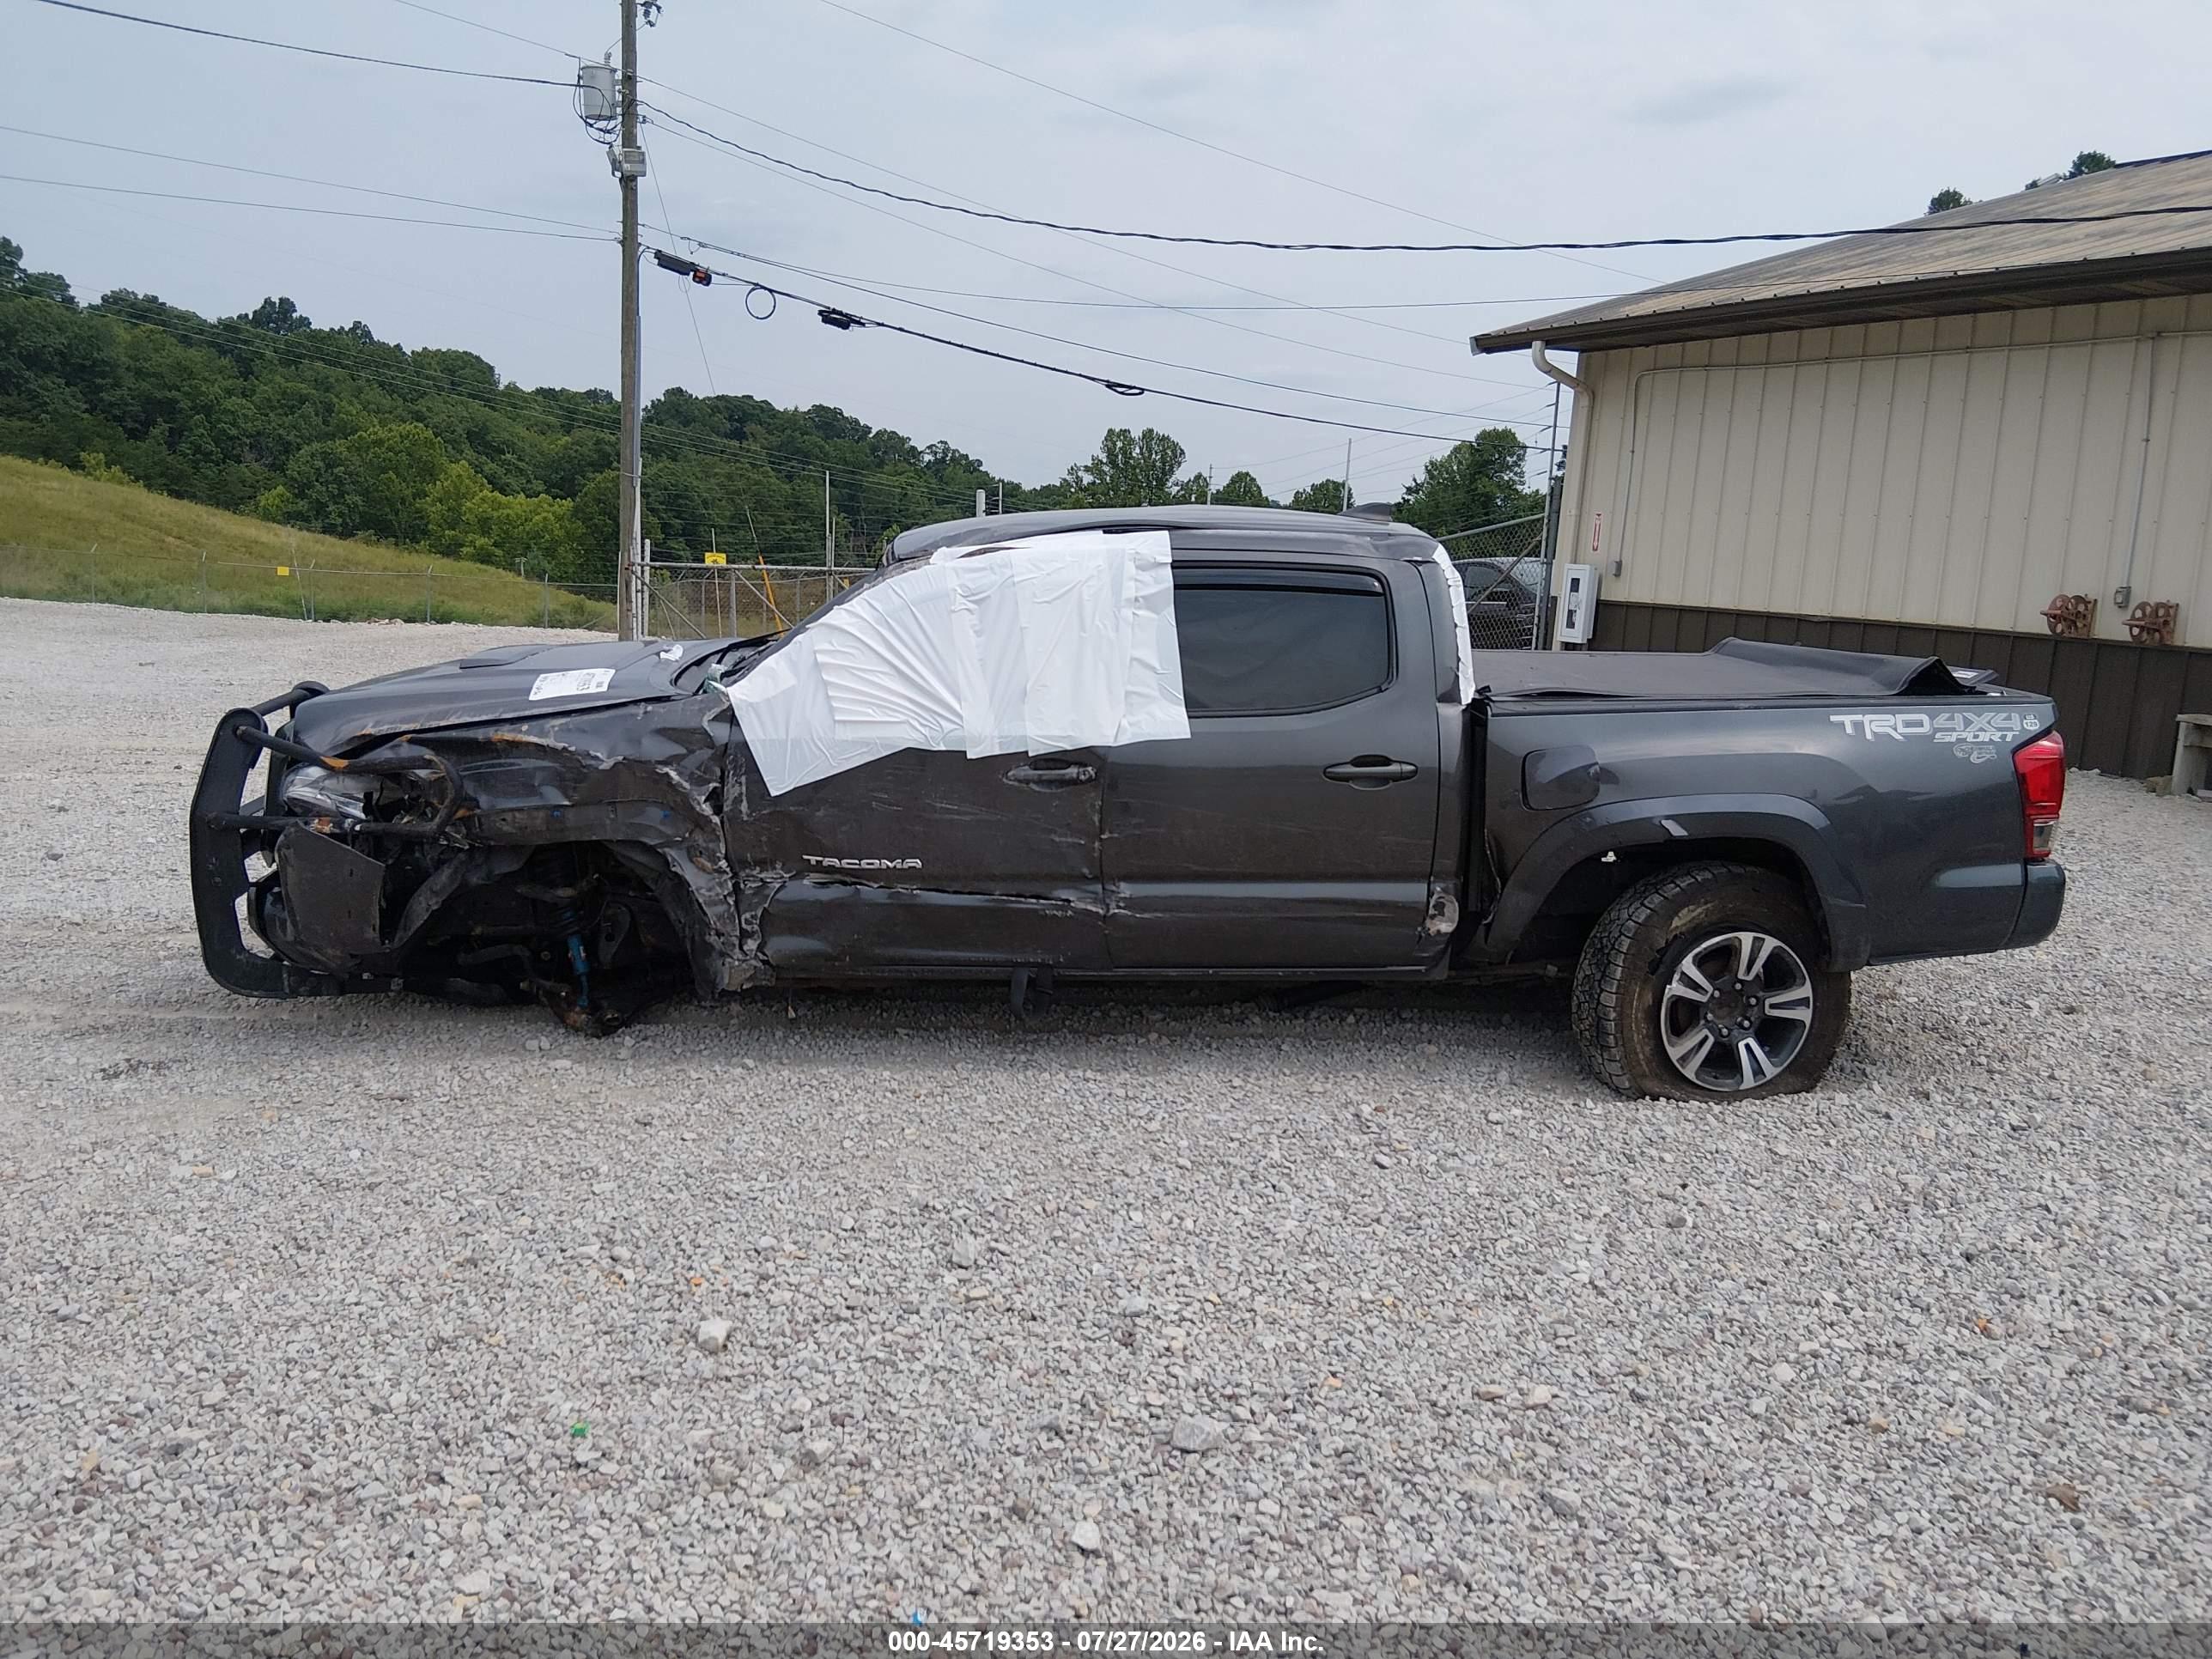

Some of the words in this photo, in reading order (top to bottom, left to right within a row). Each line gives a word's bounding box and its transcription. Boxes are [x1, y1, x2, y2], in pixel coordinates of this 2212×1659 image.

[1829, 714, 1932, 741] TRD
[1933, 713, 2020, 731] 4X4
[1933, 731, 2020, 743] SPORT
[802, 854, 923, 869] TACOMA
